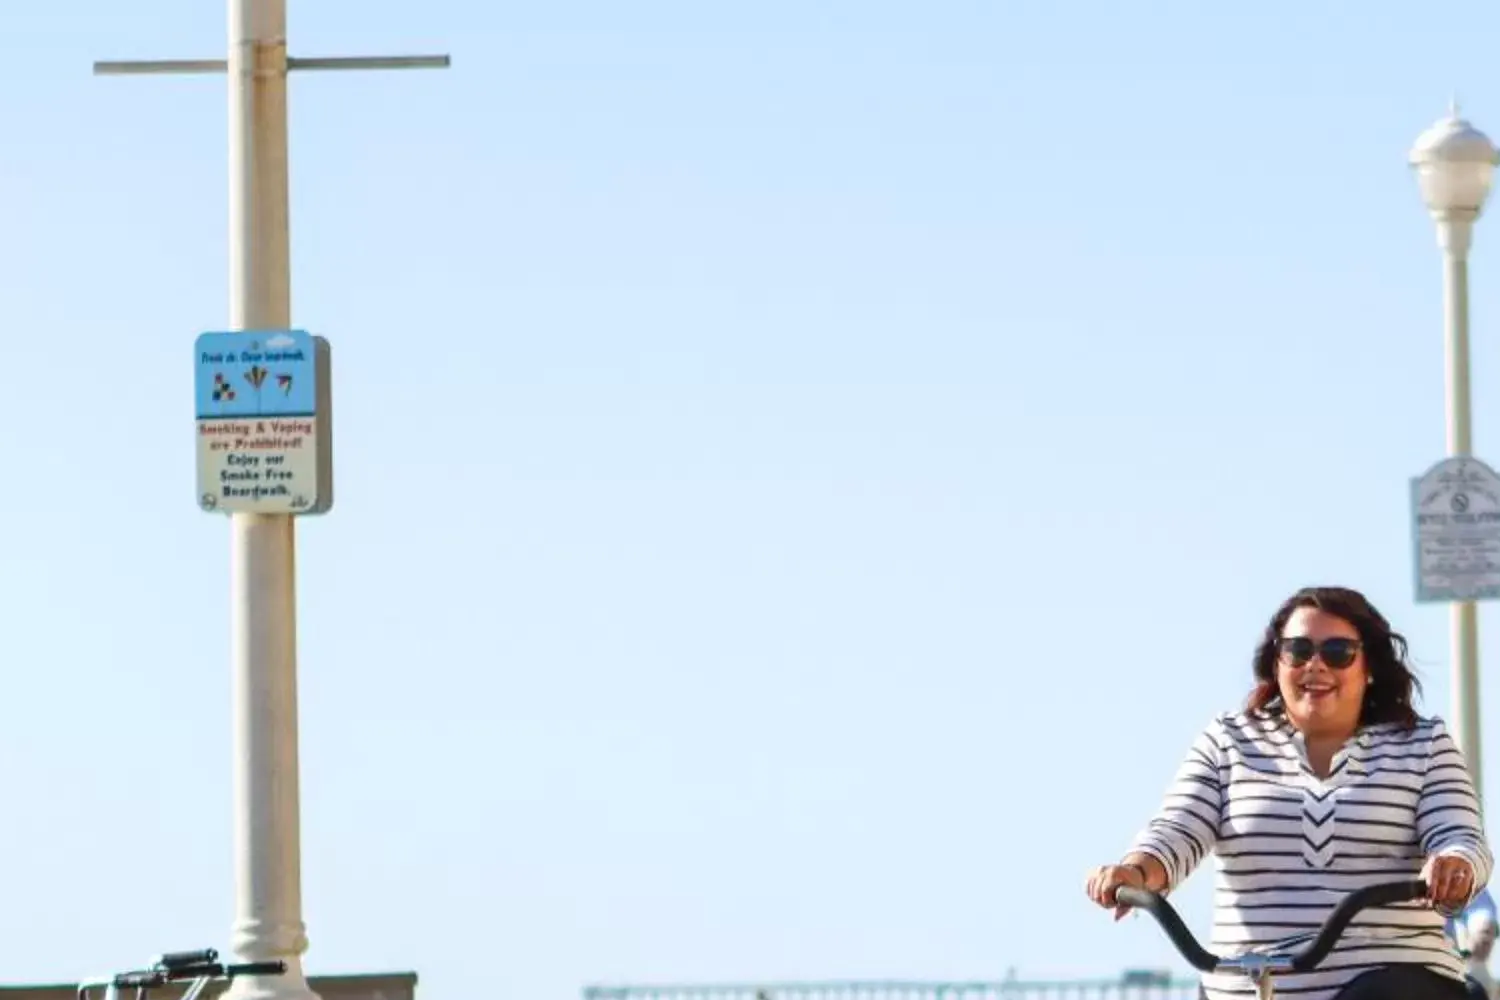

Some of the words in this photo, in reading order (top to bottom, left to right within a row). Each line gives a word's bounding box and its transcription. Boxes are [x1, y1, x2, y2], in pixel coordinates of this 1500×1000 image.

[200, 424, 249, 435] Smoking
[256, 422, 265, 433] &
[271, 421, 311, 434] Vaping
[227, 454, 259, 466] Enjoy
[265, 456, 284, 465] our
[221, 470, 259, 481] Smoke
[265, 469, 294, 479] Free
